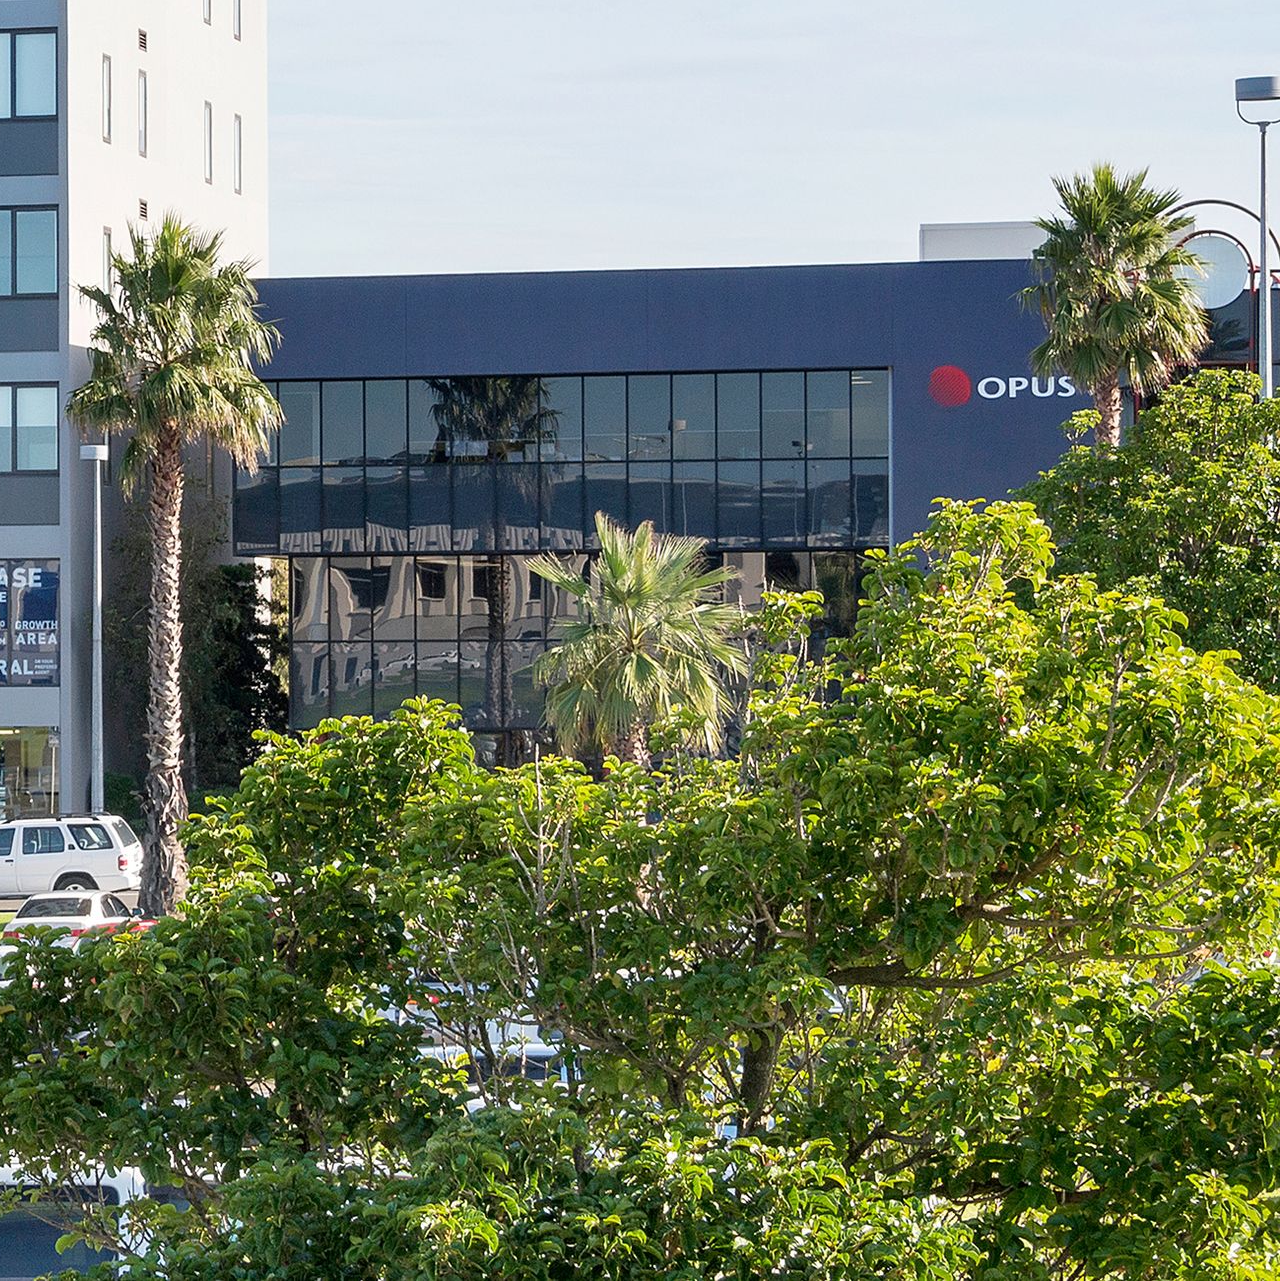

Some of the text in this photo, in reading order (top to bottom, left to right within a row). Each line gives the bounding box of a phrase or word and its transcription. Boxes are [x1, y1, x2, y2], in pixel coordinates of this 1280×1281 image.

[977, 376, 1076, 399] OPUS
[15, 620, 58, 630] GROWTH
[16, 633, 58, 644] AREA
